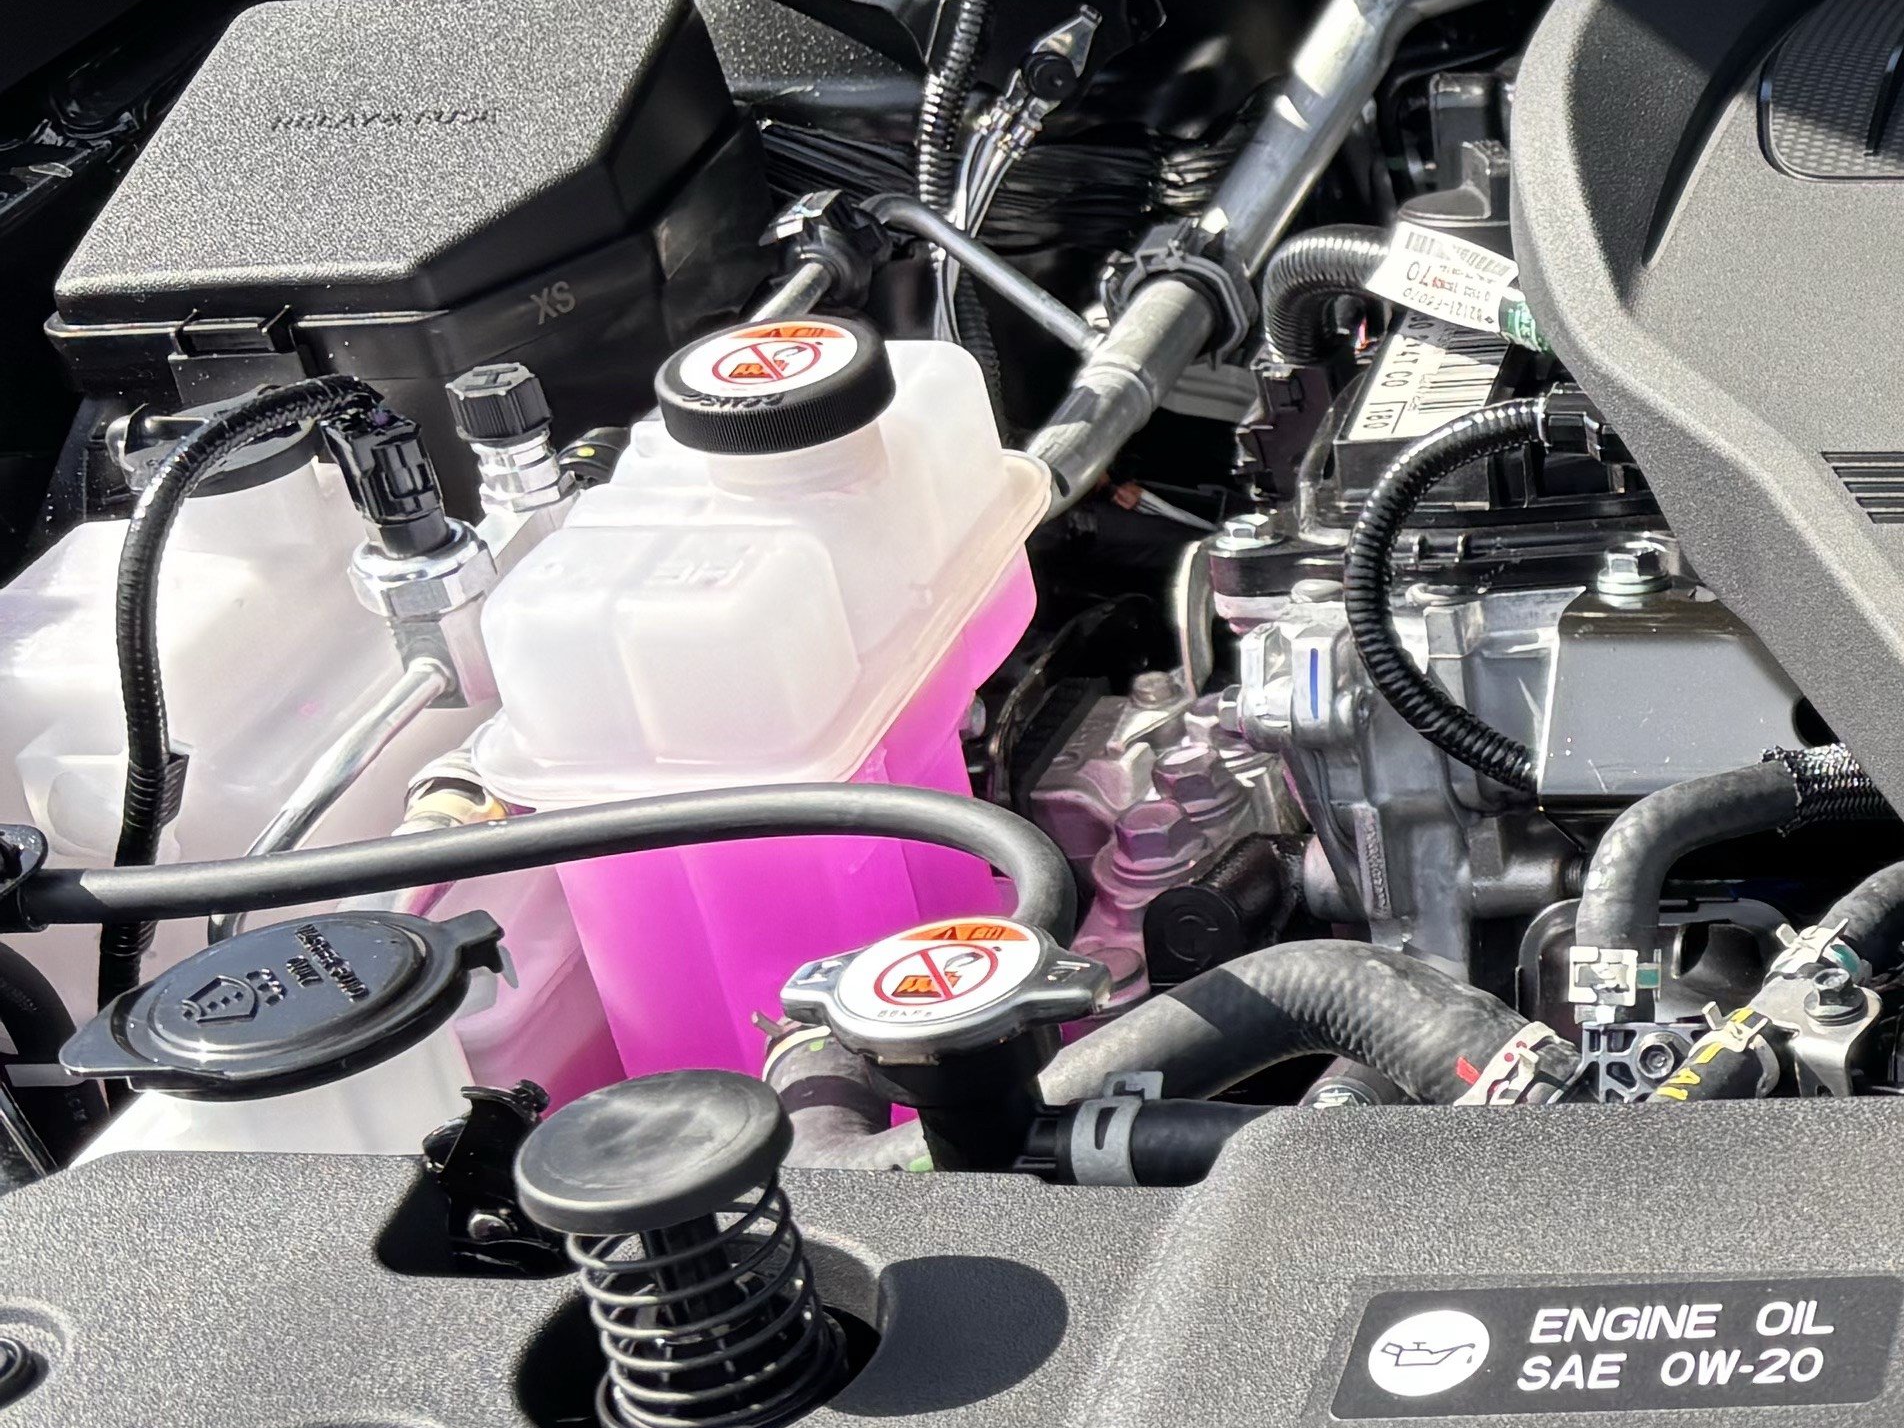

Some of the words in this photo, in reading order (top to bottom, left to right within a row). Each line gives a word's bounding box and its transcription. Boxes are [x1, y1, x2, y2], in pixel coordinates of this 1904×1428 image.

[530, 281, 576, 325] XS
[1528, 1302, 1723, 1344] ENGINE
[1754, 1299, 1835, 1337] OIL
[1516, 1352, 1627, 1390] SAE
[1659, 1346, 1824, 1388] 0W-20
